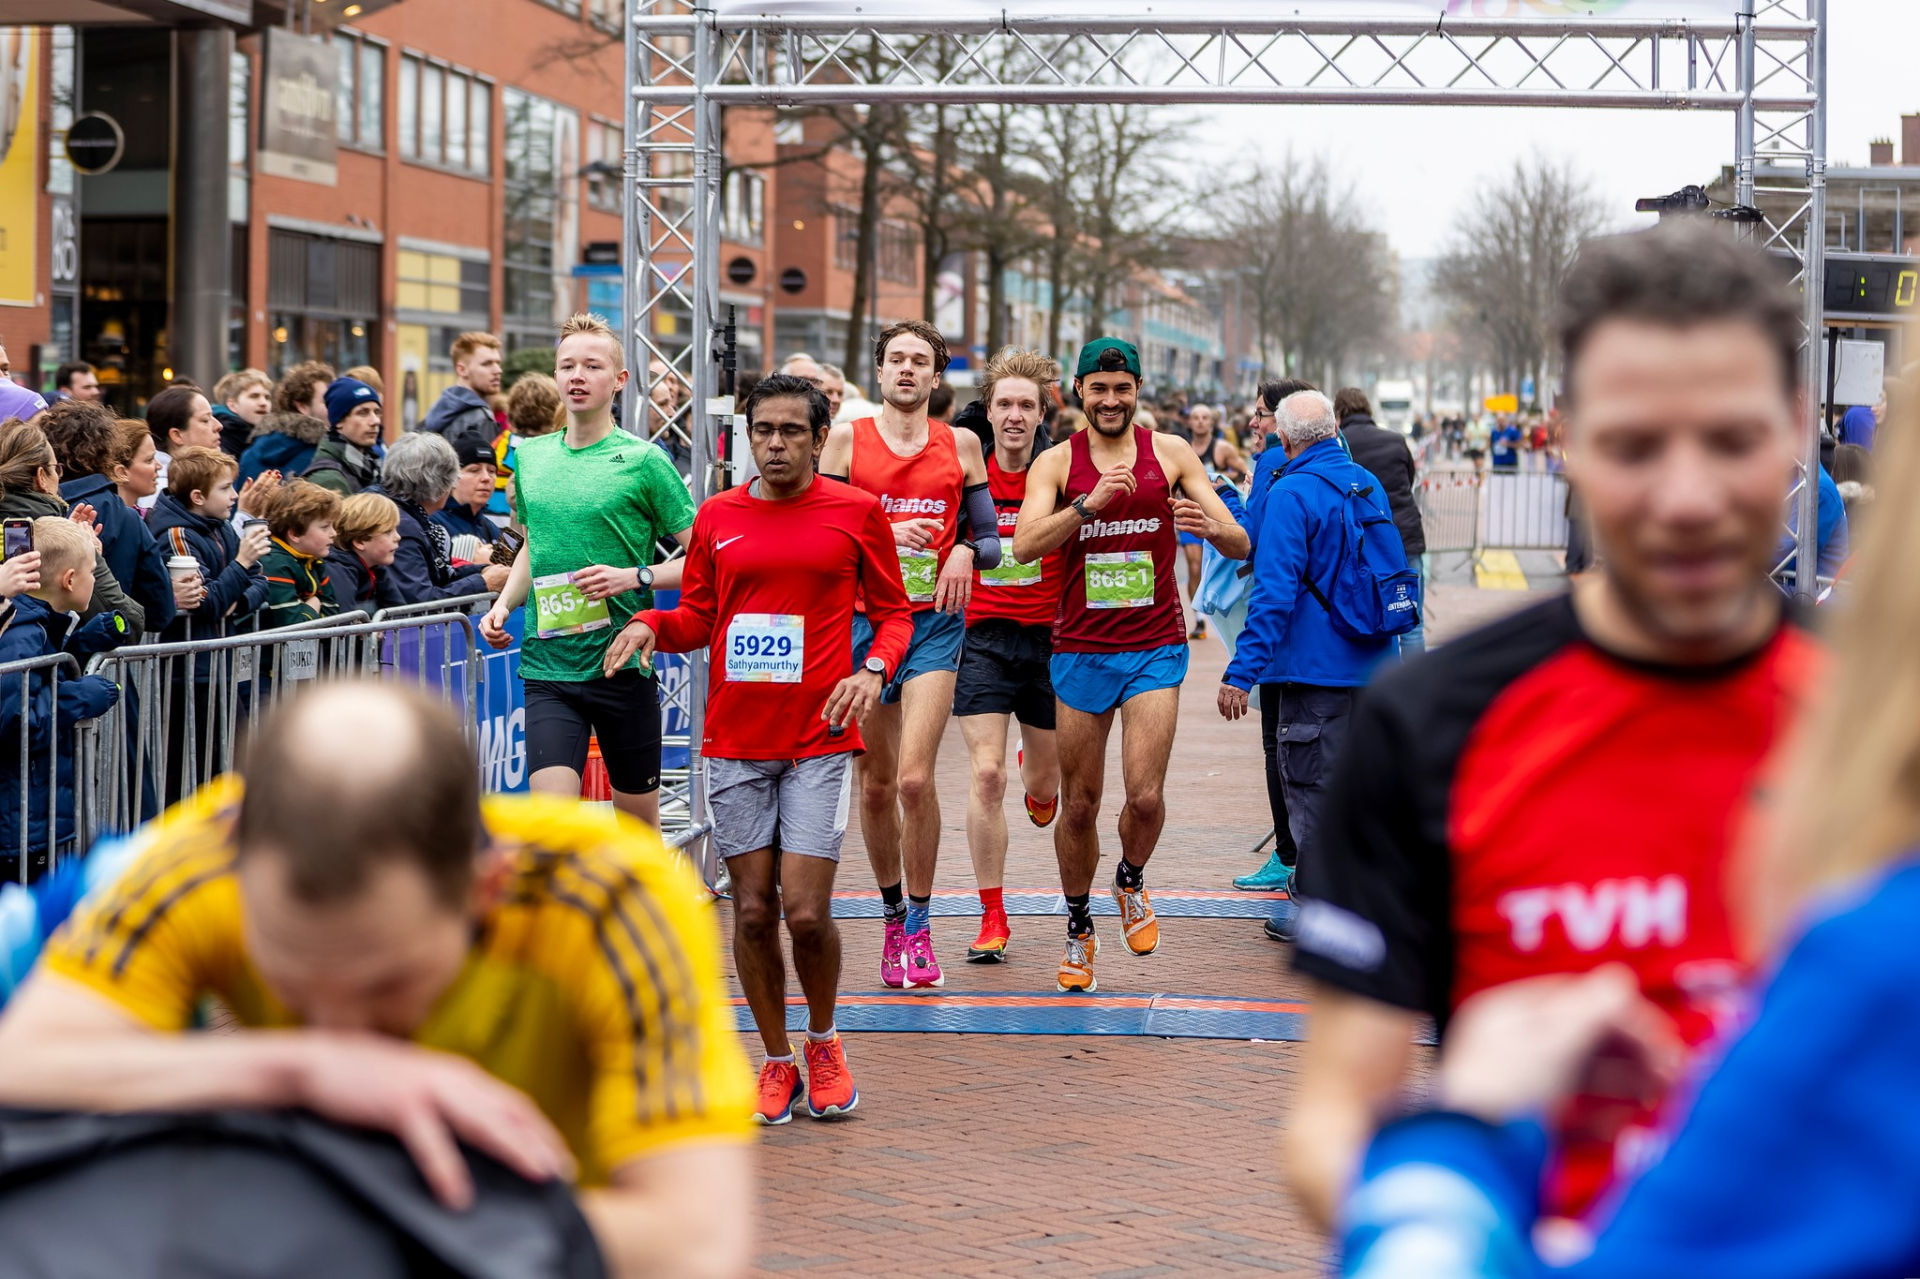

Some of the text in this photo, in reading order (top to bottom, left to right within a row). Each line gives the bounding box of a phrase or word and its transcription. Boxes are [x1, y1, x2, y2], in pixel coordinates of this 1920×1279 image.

[1079, 518, 1162, 541] phanos
[1089, 568, 1148, 588] 865-1
[734, 635, 792, 656] 5929
[728, 659, 799, 672] Sathyamurthy
[1499, 874, 1688, 954] TVH
